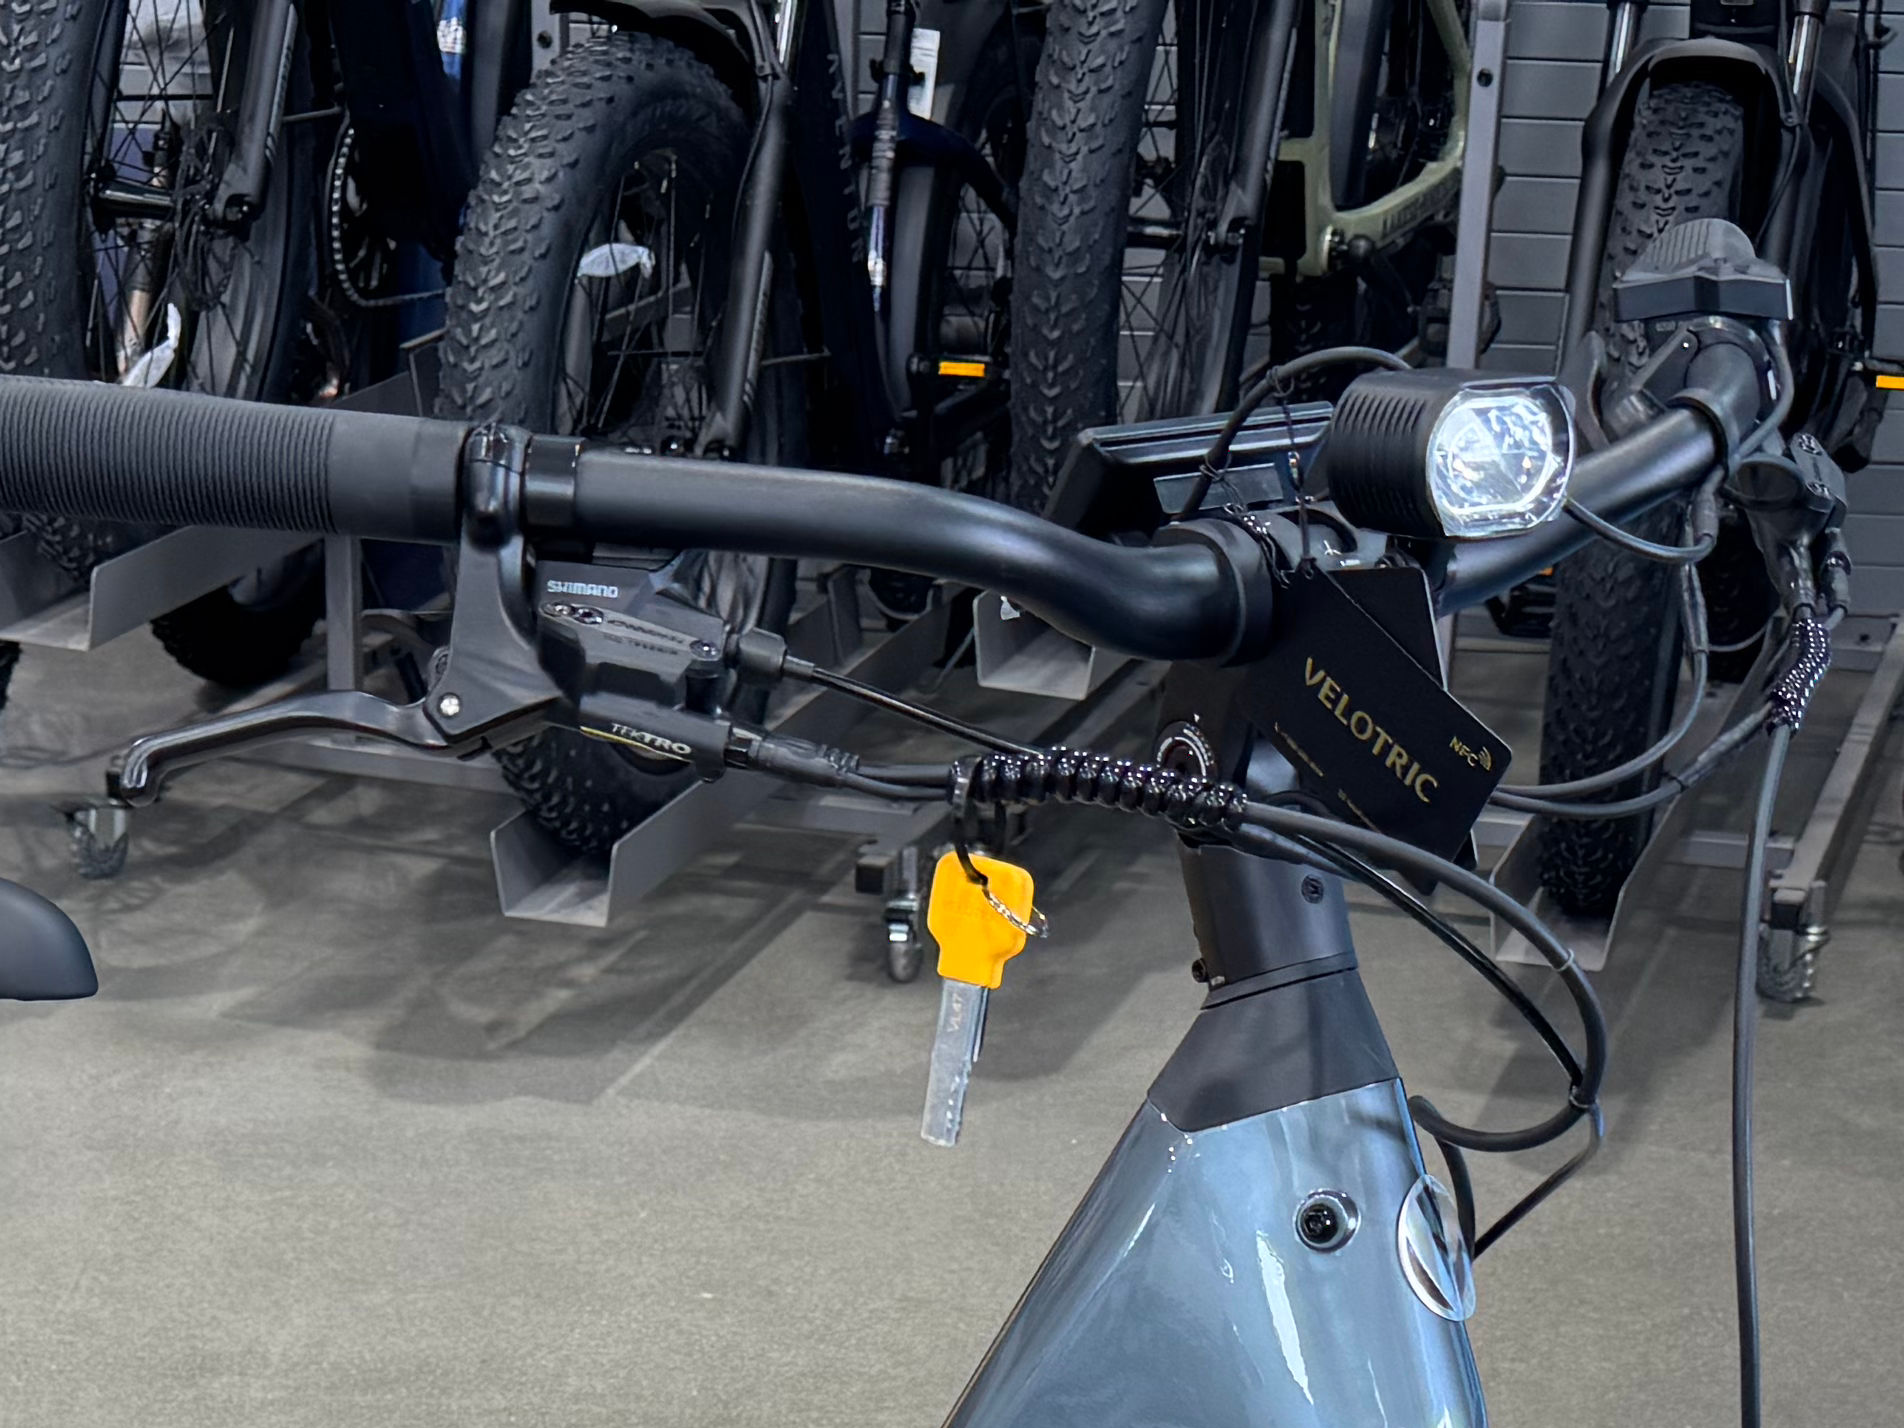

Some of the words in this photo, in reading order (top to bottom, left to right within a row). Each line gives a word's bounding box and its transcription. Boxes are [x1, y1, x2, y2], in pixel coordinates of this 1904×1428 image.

[547, 579, 619, 598] SHIMANO
[611, 722, 692, 755] TEKTRO
[1303, 656, 1439, 804] VELOTRIC
[1449, 736, 1478, 767] NFC
